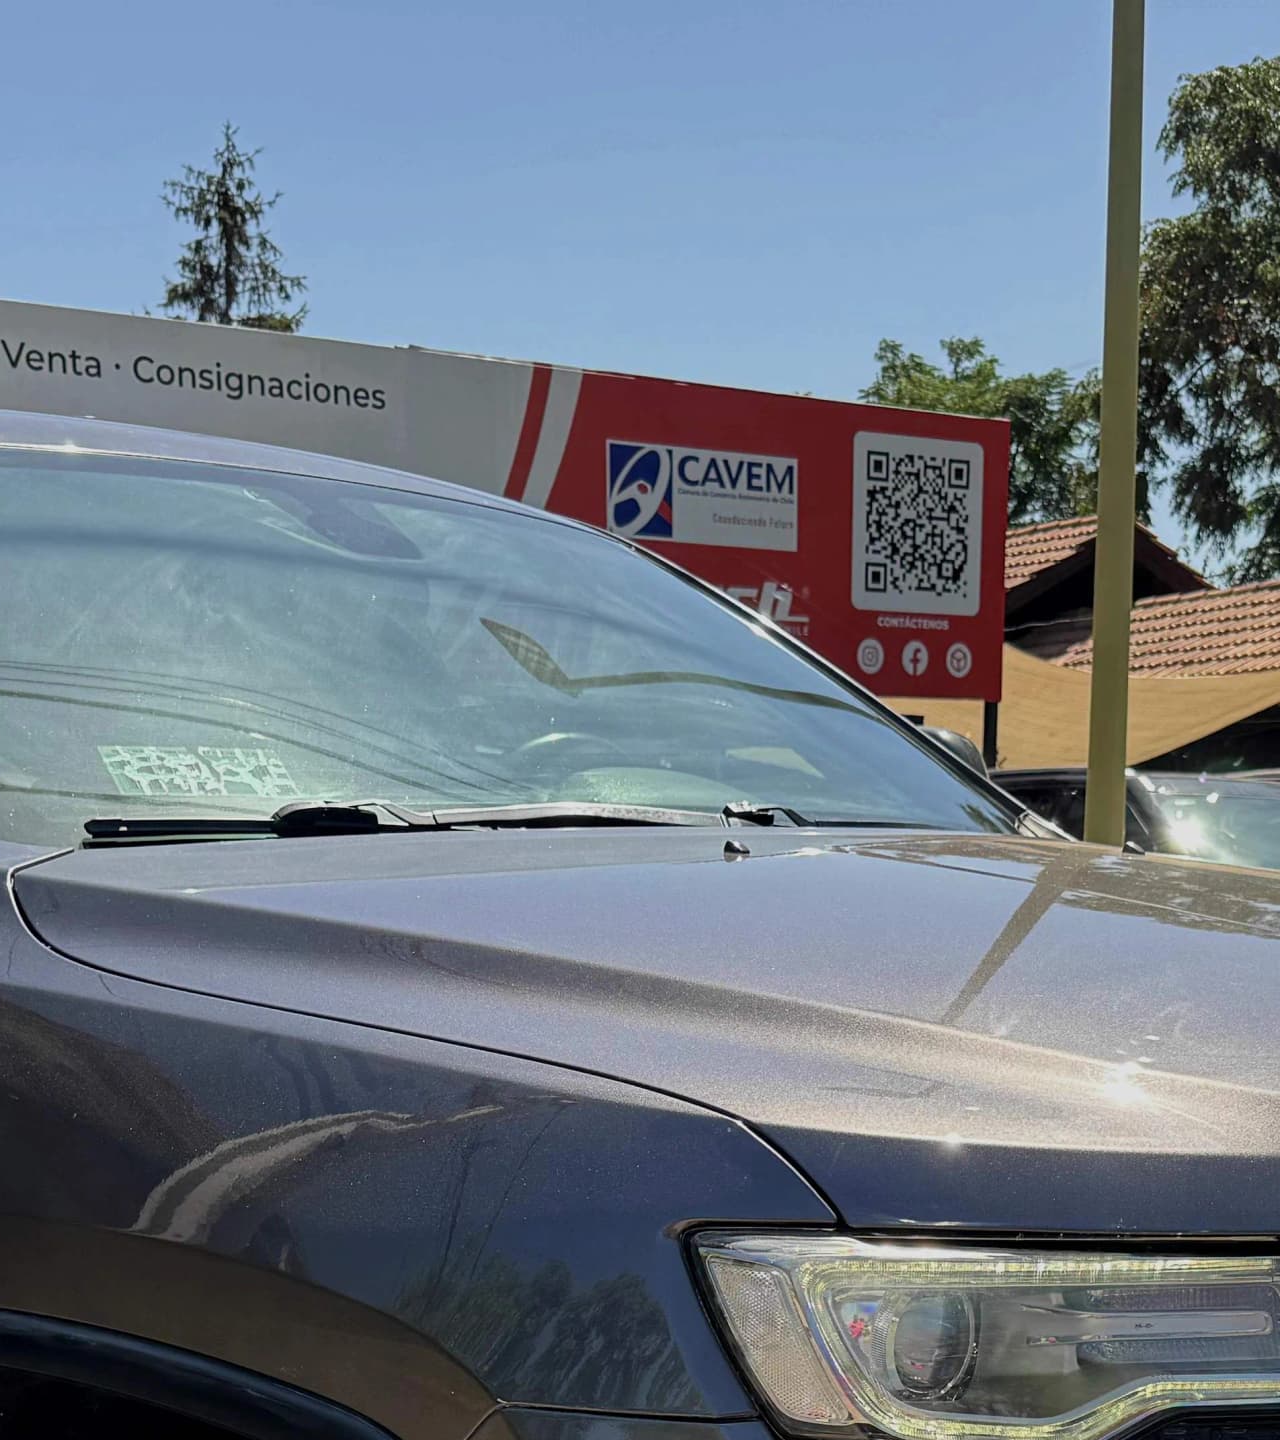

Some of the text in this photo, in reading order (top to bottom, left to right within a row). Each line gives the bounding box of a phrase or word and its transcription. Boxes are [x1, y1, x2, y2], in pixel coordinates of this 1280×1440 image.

[1, 339, 103, 380] Venta
[132, 355, 387, 411] Consignaciones
[677, 454, 795, 495] CAVEM
